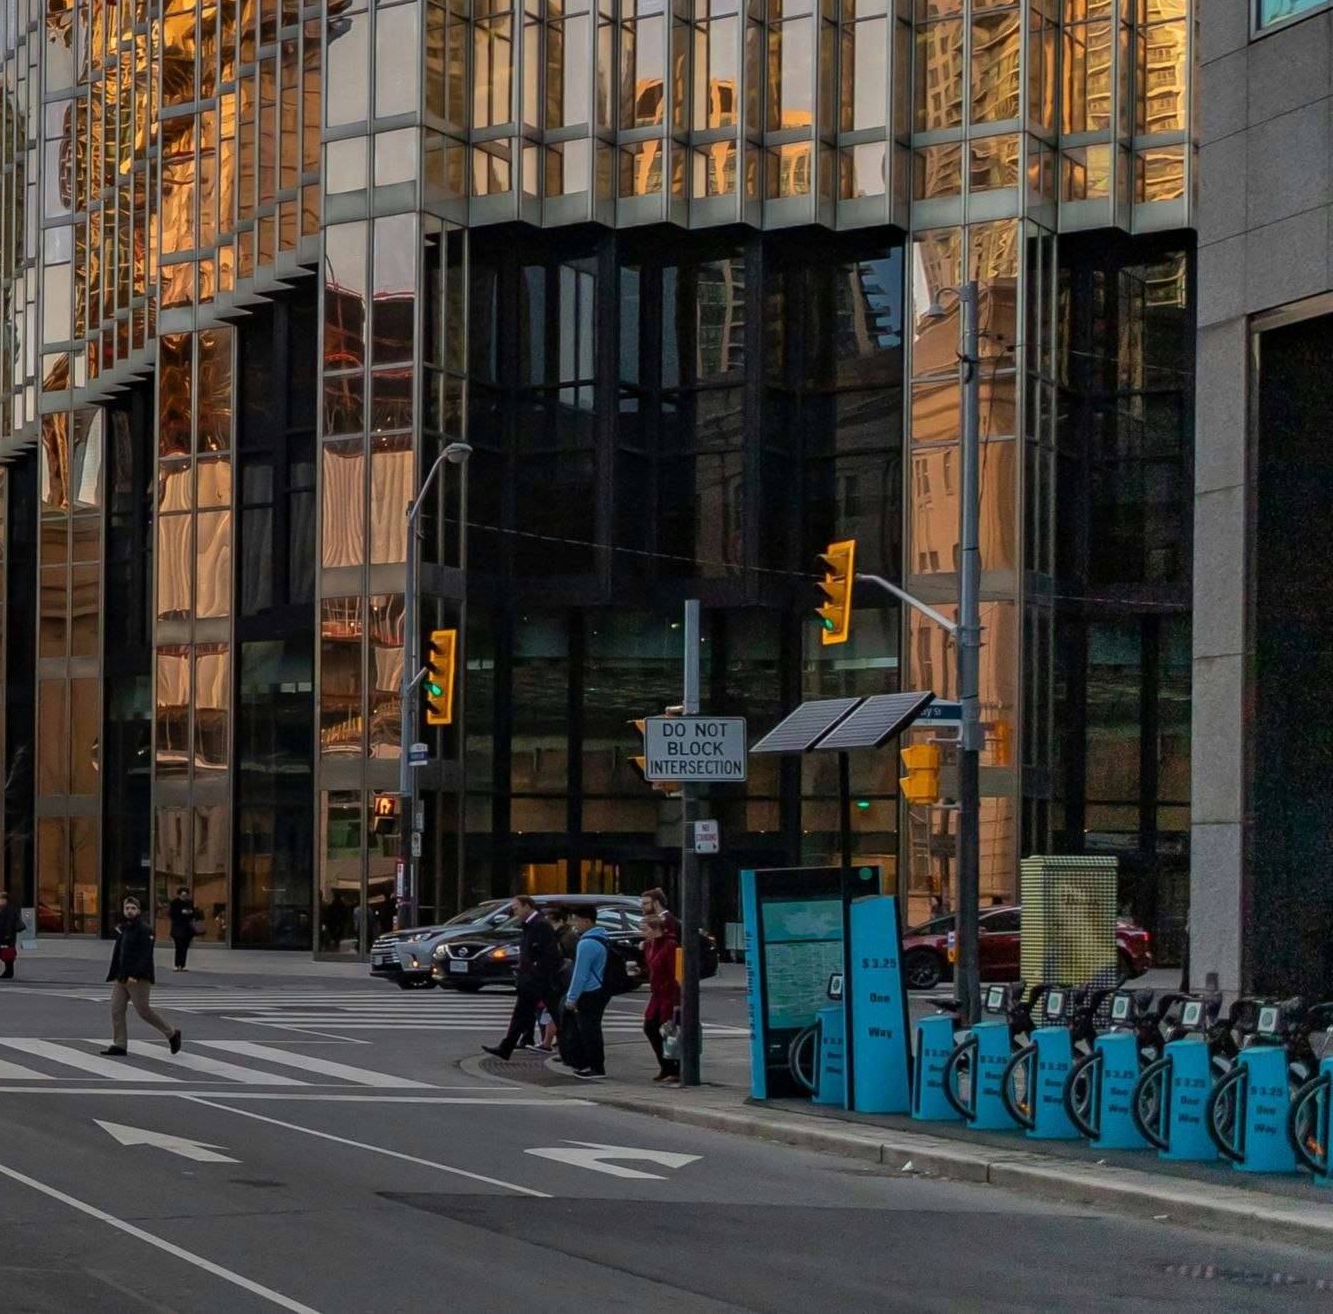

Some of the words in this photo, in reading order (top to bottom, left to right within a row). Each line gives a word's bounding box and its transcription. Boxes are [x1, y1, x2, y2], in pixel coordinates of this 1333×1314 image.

[662, 723, 686, 737] DO
[695, 723, 728, 737] NOT
[667, 741, 724, 756] BLOCK
[650, 760, 742, 775] INTERSECTION
[869, 992, 891, 1003] One
[868, 1027, 892, 1039] Way
